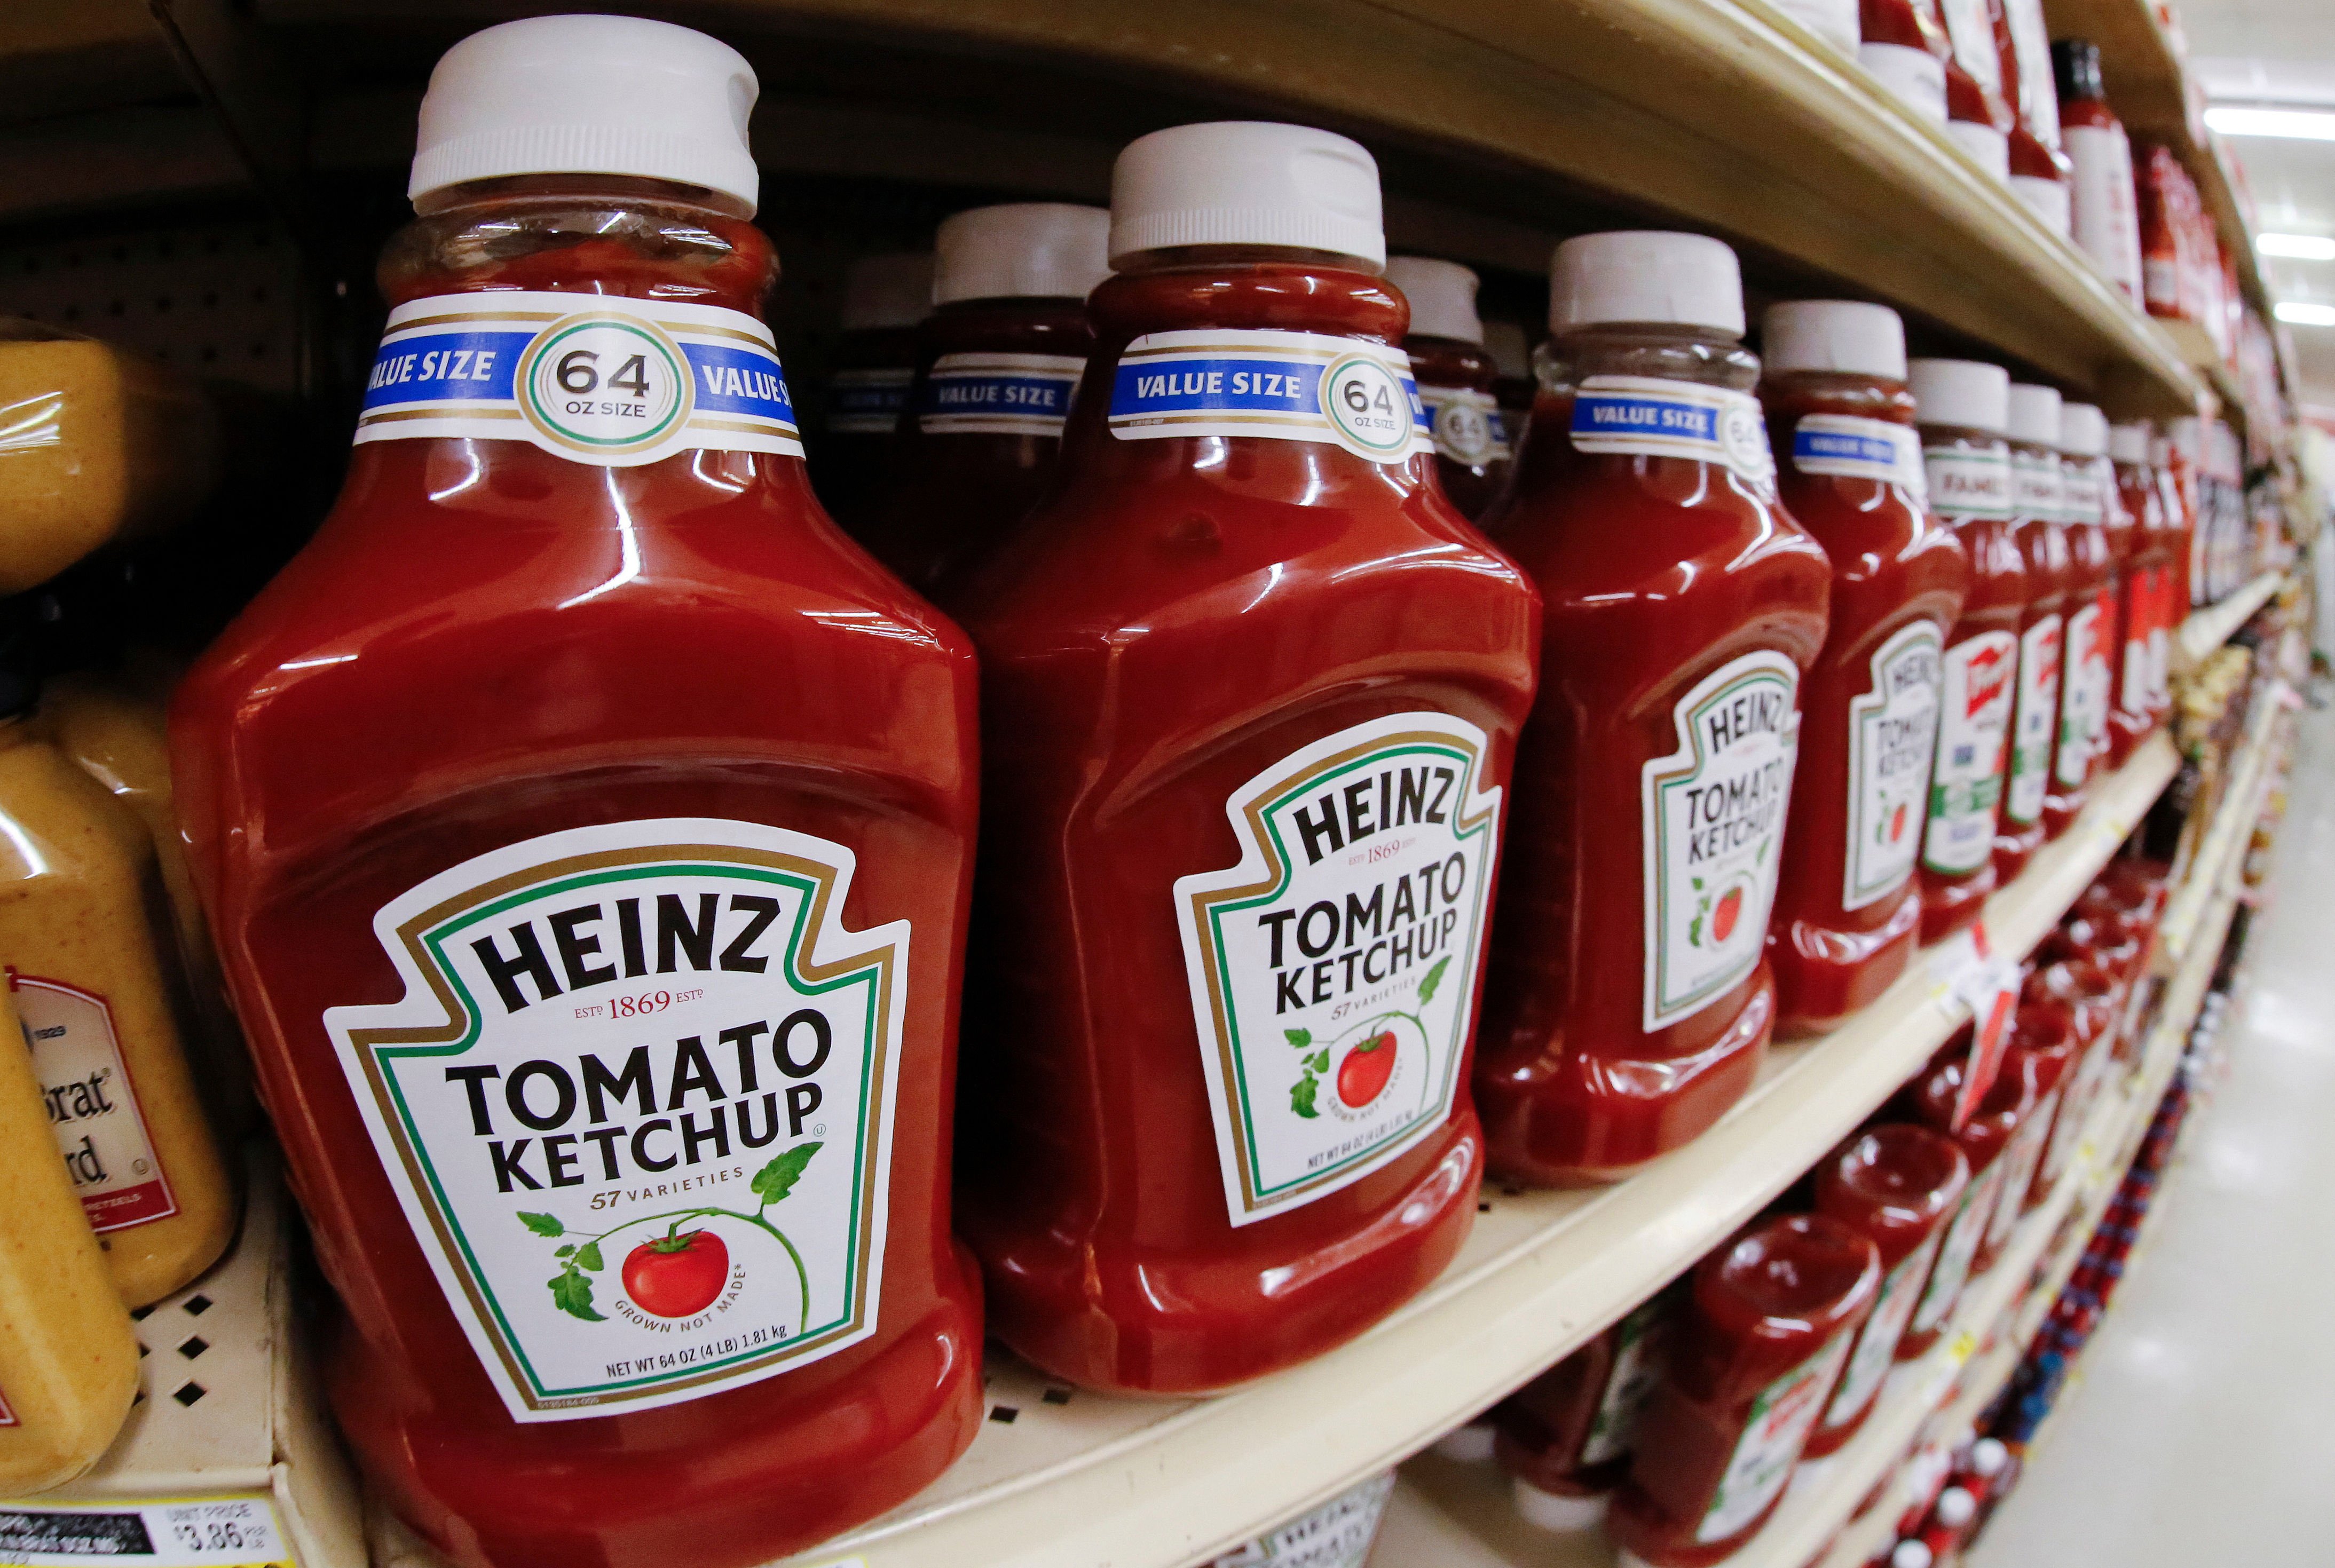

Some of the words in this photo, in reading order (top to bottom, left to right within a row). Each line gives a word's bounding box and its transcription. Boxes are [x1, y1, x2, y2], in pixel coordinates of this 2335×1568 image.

[367, 353, 418, 391] ALUE
[418, 350, 497, 382] SIZE
[557, 350, 650, 397] 64
[702, 365, 782, 403] VALUE
[1138, 372, 1224, 399] VALUE
[1232, 371, 1301, 399] SIZE
[566, 401, 595, 414] OZ
[601, 402, 646, 418] SIZE
[938, 385, 999, 404] VALUE
[1004, 384, 1055, 407] SIZE
[1344, 380, 1393, 416] 64
[1355, 417, 1371, 427] OZ
[1374, 418, 1396, 430] SIZE
[1593, 406, 1658, 425] VALUE
[1661, 408, 1707, 433] SIZE
[1709, 690, 1782, 755] HEINZ
[1292, 766, 1455, 866] HEINZ
[1368, 839, 1400, 864] 1869
[1258, 851, 1467, 970] TOMATO
[471, 893, 781, 1014] HEINZ
[1275, 908, 1457, 1015] KETCHUP
[608, 991, 670, 1019] 1869
[1331, 1001, 1352, 1020] 57
[445, 1009, 832, 1136] TOMATO
[487, 1082, 823, 1194] KETCHUP
[589, 1190, 622, 1210] 57
[626, 1167, 743, 1201] VARIETIES
[615, 1300, 671, 1333] GROWN
[681, 1312, 713, 1332] NOT
[606, 1361, 631, 1378] NET
[635, 1357, 654, 1373] WT
[659, 1353, 675, 1368] 64
[679, 1348, 697, 1364] OZ
[700, 1344, 713, 1359] (4
[716, 1336, 738, 1355] LB)
[742, 1328, 768, 1349] 1.81
[771, 1324, 787, 1339] kg
